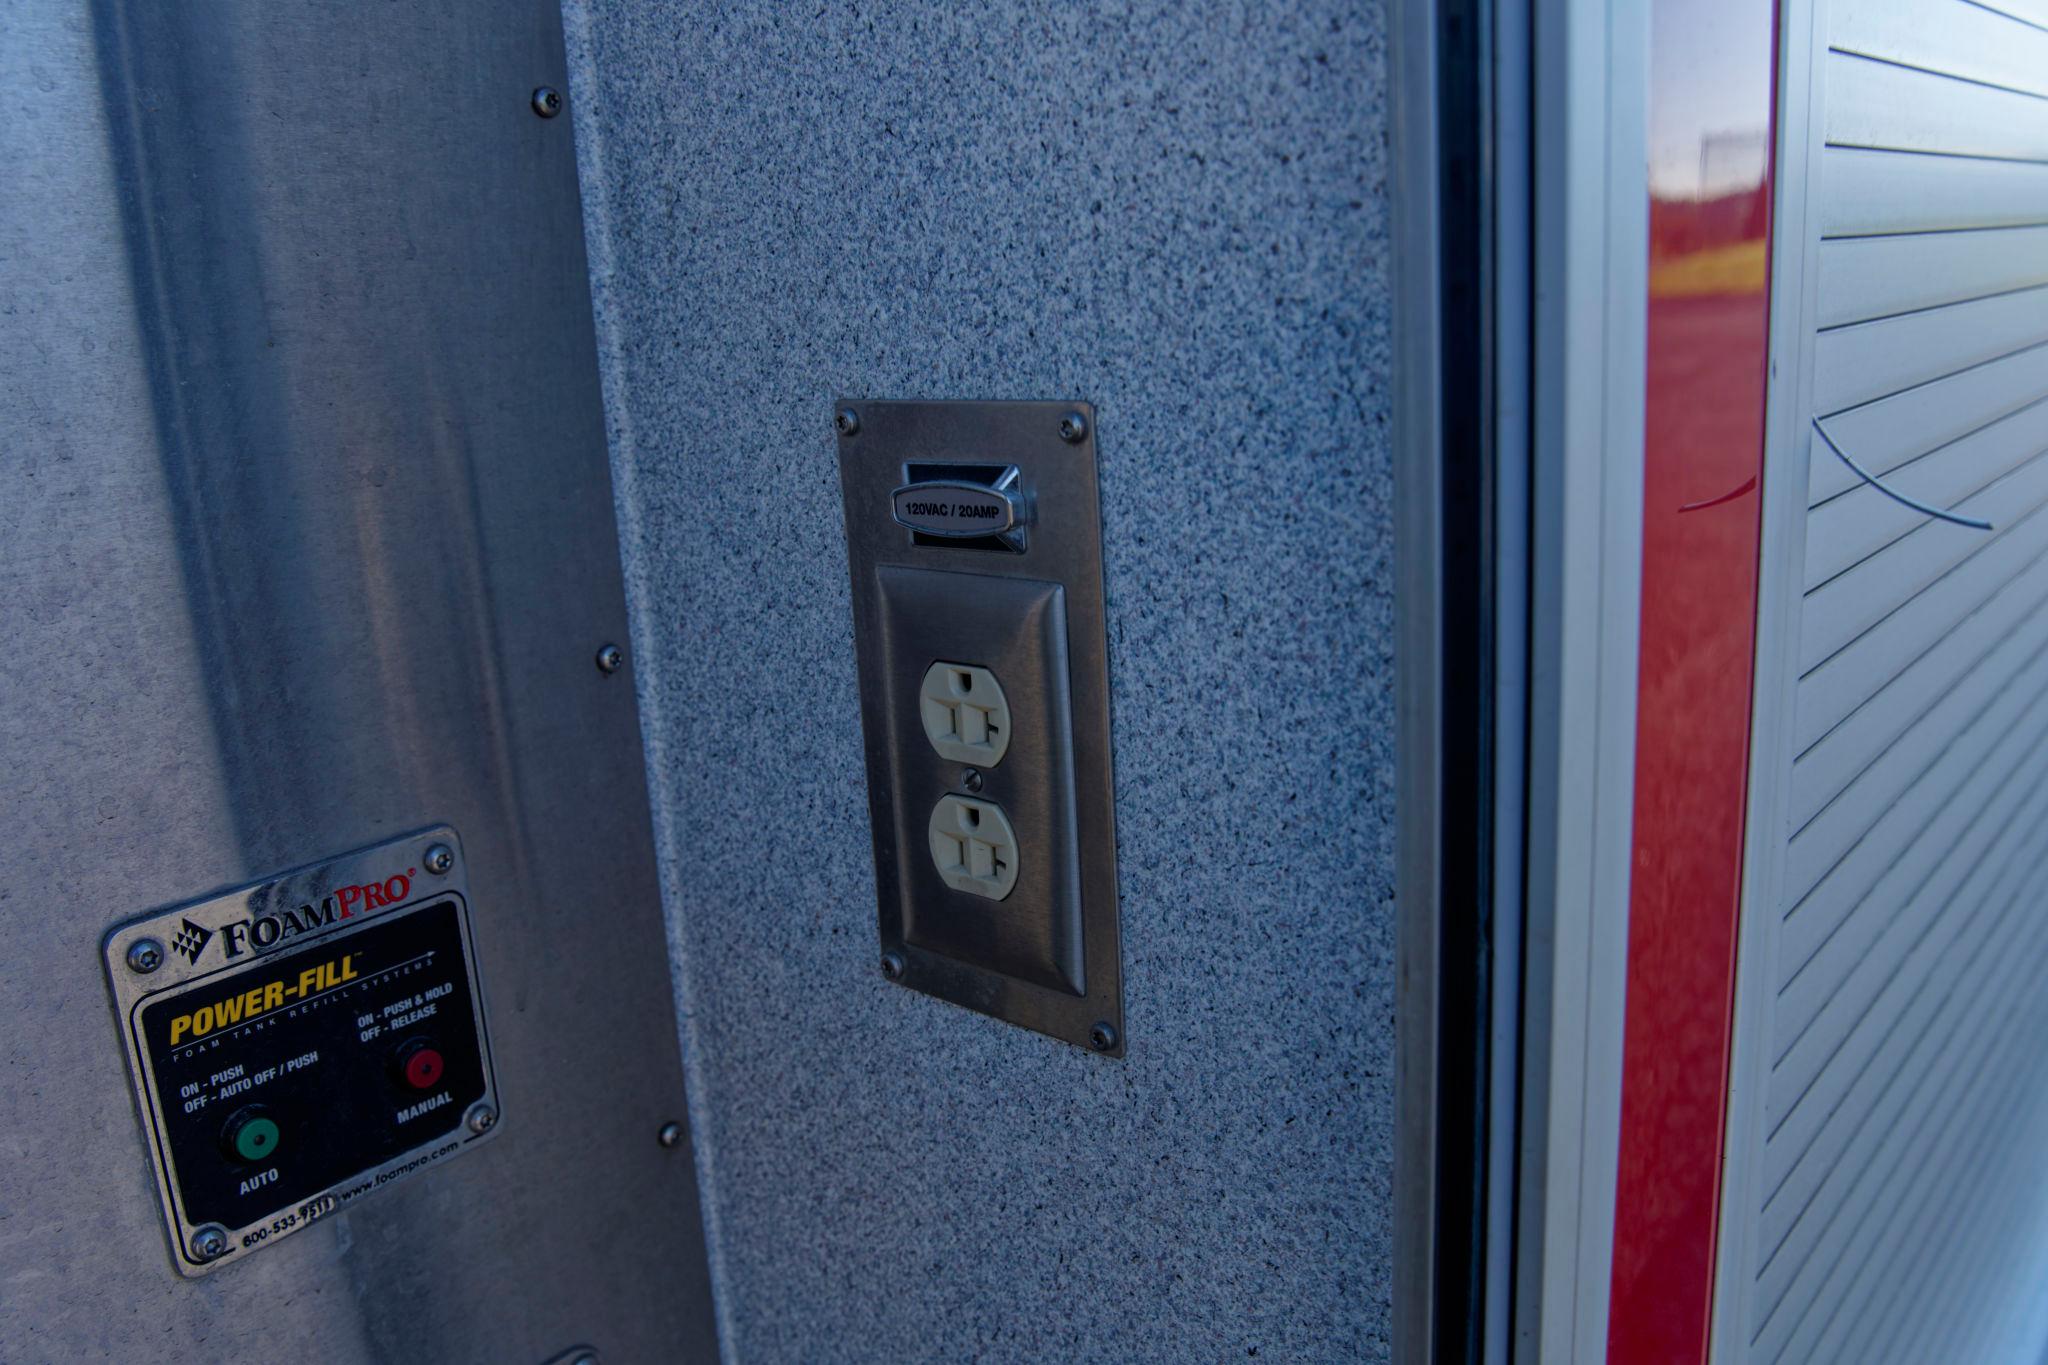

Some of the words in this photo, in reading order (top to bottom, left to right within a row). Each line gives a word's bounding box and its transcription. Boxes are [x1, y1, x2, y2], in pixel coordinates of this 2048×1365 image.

[905, 502, 948, 517] 120VAC
[951, 504, 956, 517] /
[958, 504, 1000, 519] 20AMP
[170, 955, 358, 1046] POWER-FILL
[173, 1039, 220, 1063] FOAM
[233, 1018, 276, 1039] TANK
[290, 991, 349, 1019] REFILL
[361, 958, 433, 991] SYSTEMS
[357, 1013, 374, 1028] ON
[383, 998, 413, 1018] PUSH
[414, 994, 423, 1006] &
[425, 982, 453, 1001] HOLD
[360, 1026, 381, 1042] OFF
[390, 1003, 438, 1030] RELEASE
[180, 1082, 200, 1098] ON
[210, 1064, 245, 1086] PUSH
[184, 1095, 208, 1114] OFF
[220, 1078, 251, 1100] AUTO
[254, 1067, 277, 1085] OFF
[286, 1051, 319, 1073] PUSH
[396, 1091, 453, 1124] MANUAL
[240, 1168, 279, 1195] AUTO
[340, 1142, 459, 1200] www.foampro.com
